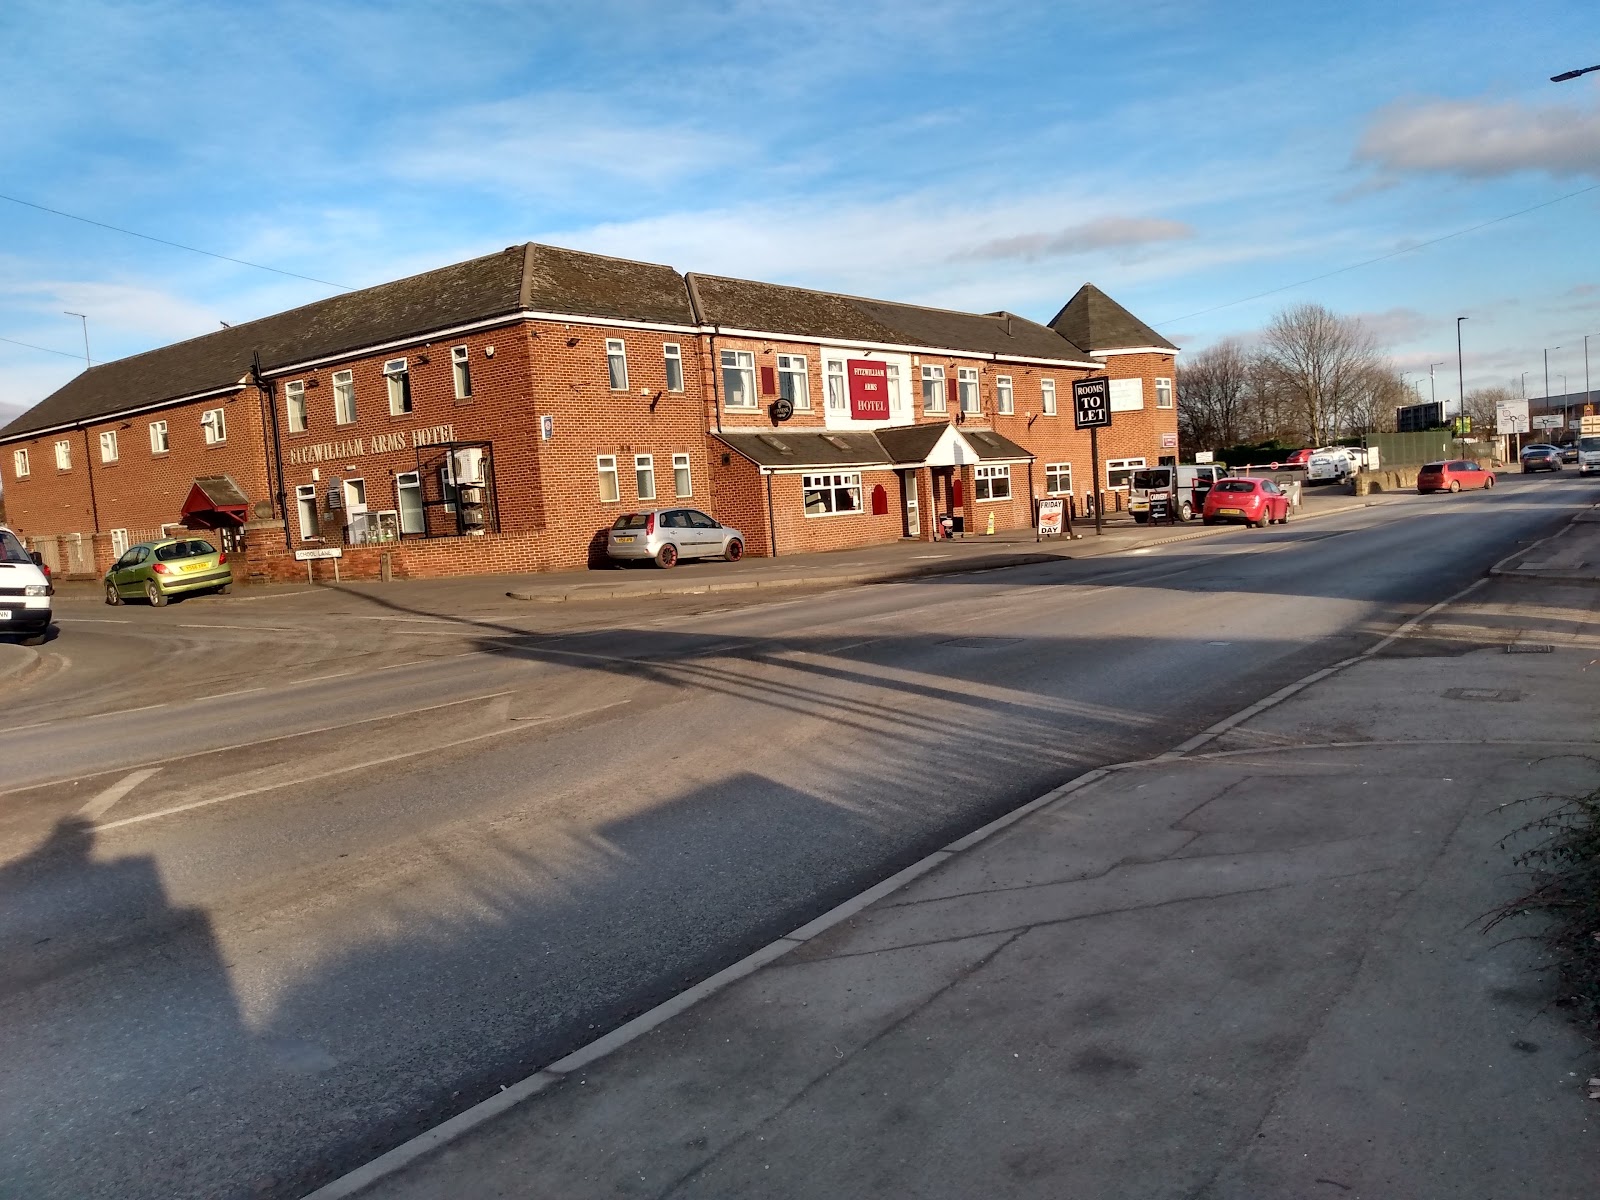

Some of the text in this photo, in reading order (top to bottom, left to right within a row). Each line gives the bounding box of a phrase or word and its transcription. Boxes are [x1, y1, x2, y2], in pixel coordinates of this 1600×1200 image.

[854, 368, 884, 376] FITZWILLIAM
[1077, 384, 1104, 396] ROOMS
[858, 400, 886, 410] HOTEL
[1081, 396, 1101, 409] TO
[1079, 409, 1105, 422] LET
[290, 424, 458, 463] FITZWILLIAM ARMS HOTEL
